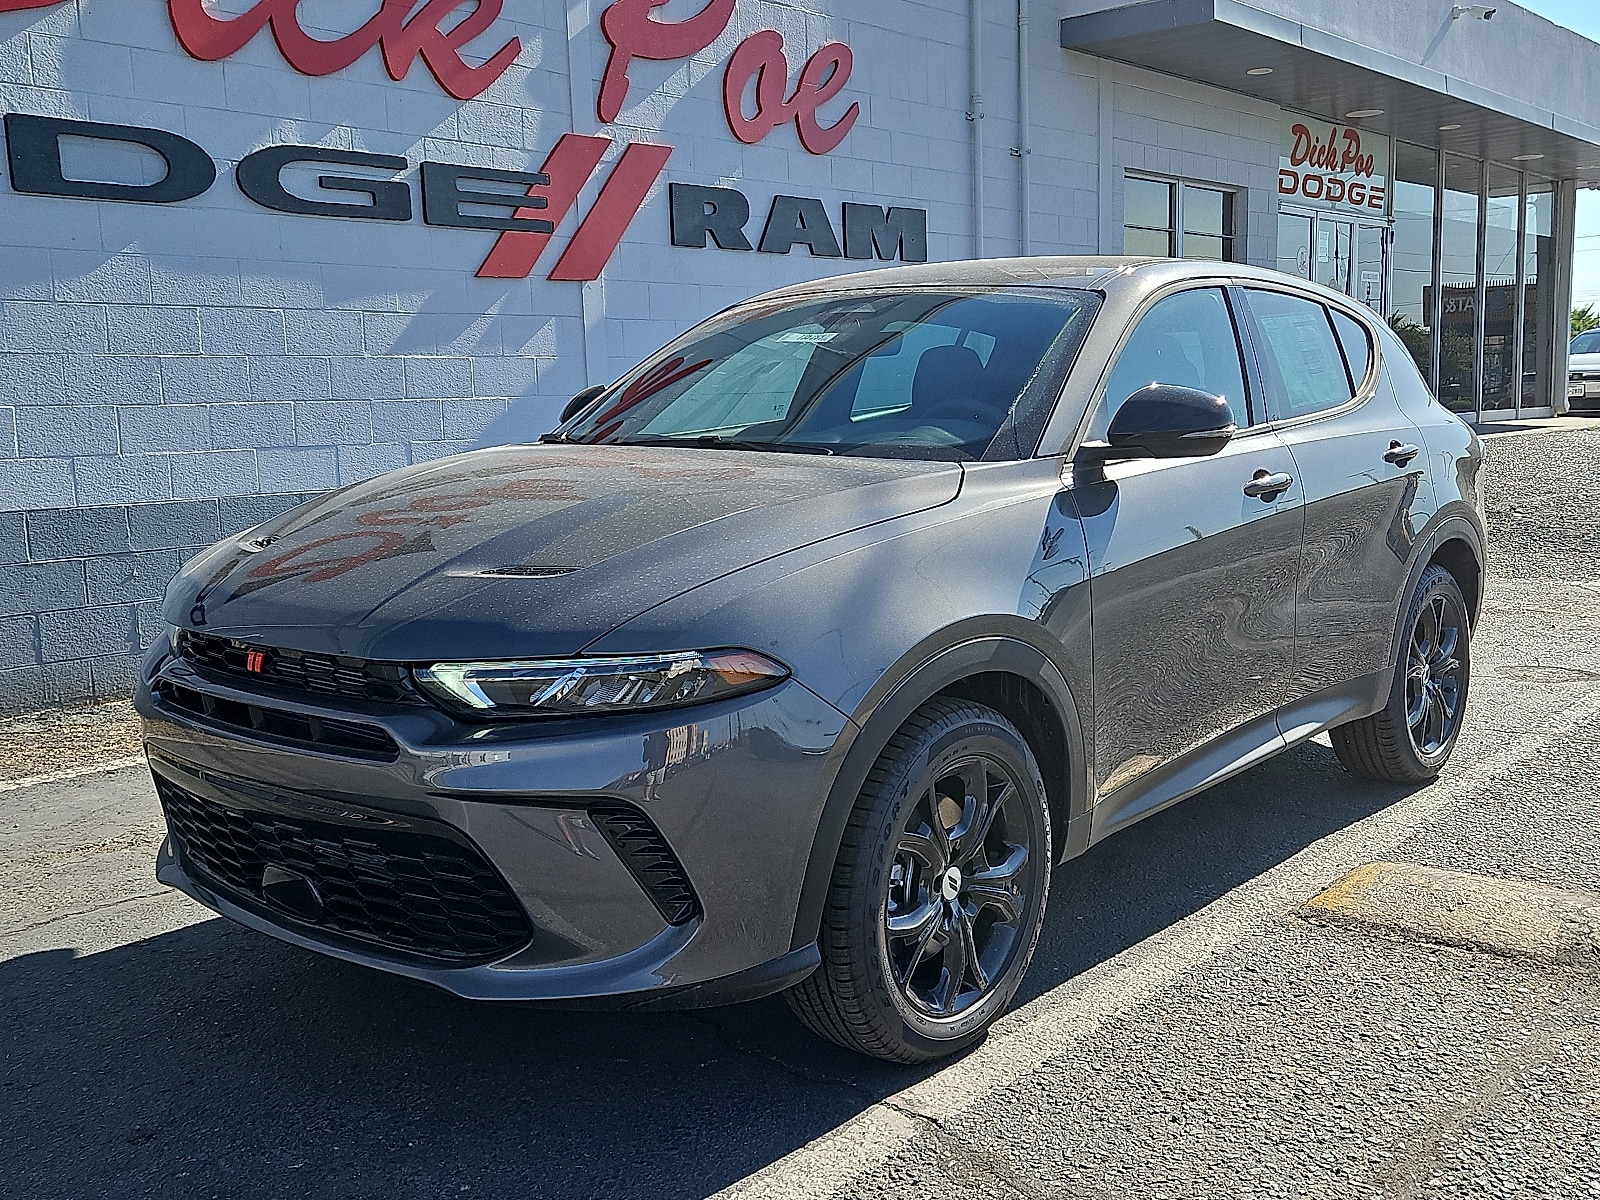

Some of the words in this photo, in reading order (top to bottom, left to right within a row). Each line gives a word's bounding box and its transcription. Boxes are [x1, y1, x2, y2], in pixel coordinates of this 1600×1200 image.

[1290, 123, 1338, 171] Dick
[1340, 128, 1375, 178] Poe
[1278, 168, 1385, 209] DODGE
[669, 181, 928, 262] RAM
